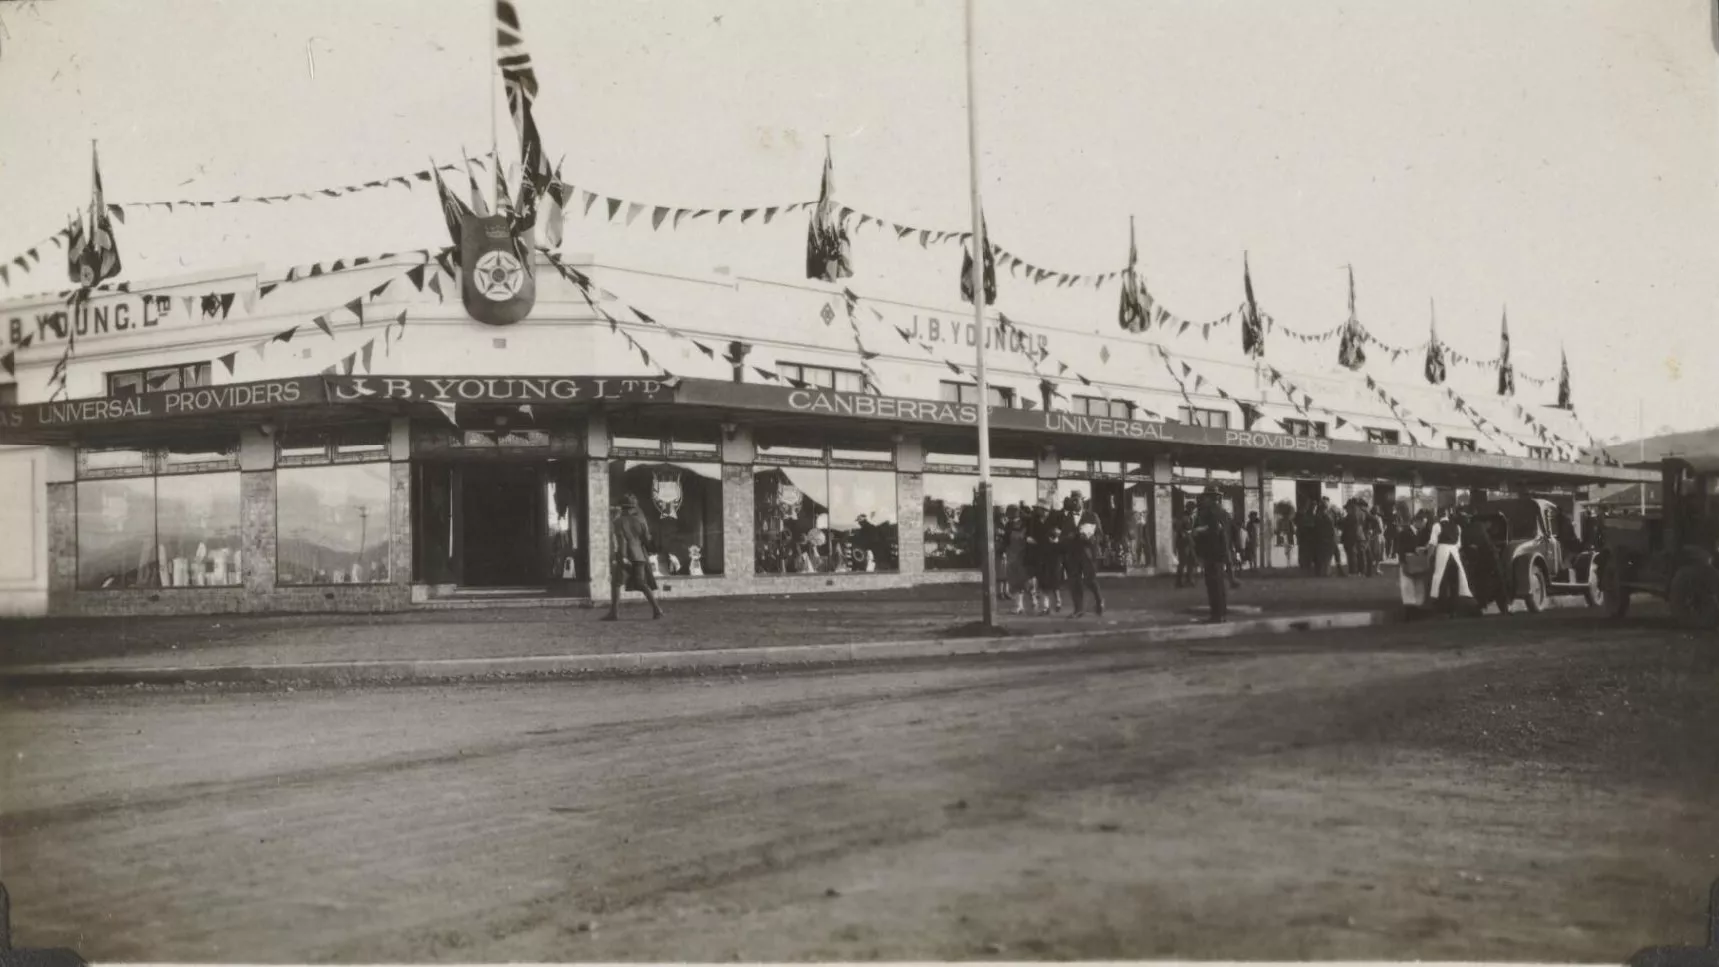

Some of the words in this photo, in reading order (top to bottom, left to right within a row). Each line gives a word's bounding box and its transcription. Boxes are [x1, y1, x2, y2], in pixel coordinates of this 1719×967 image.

[38, 396, 152, 424] UNIVERSAL
[164, 381, 301, 413] PROVIDERS
[788, 390, 977, 424] CANBERRA'S
[1045, 412, 1174, 440] UNIVERSAL
[1225, 430, 1330, 453] PROVIDERS
